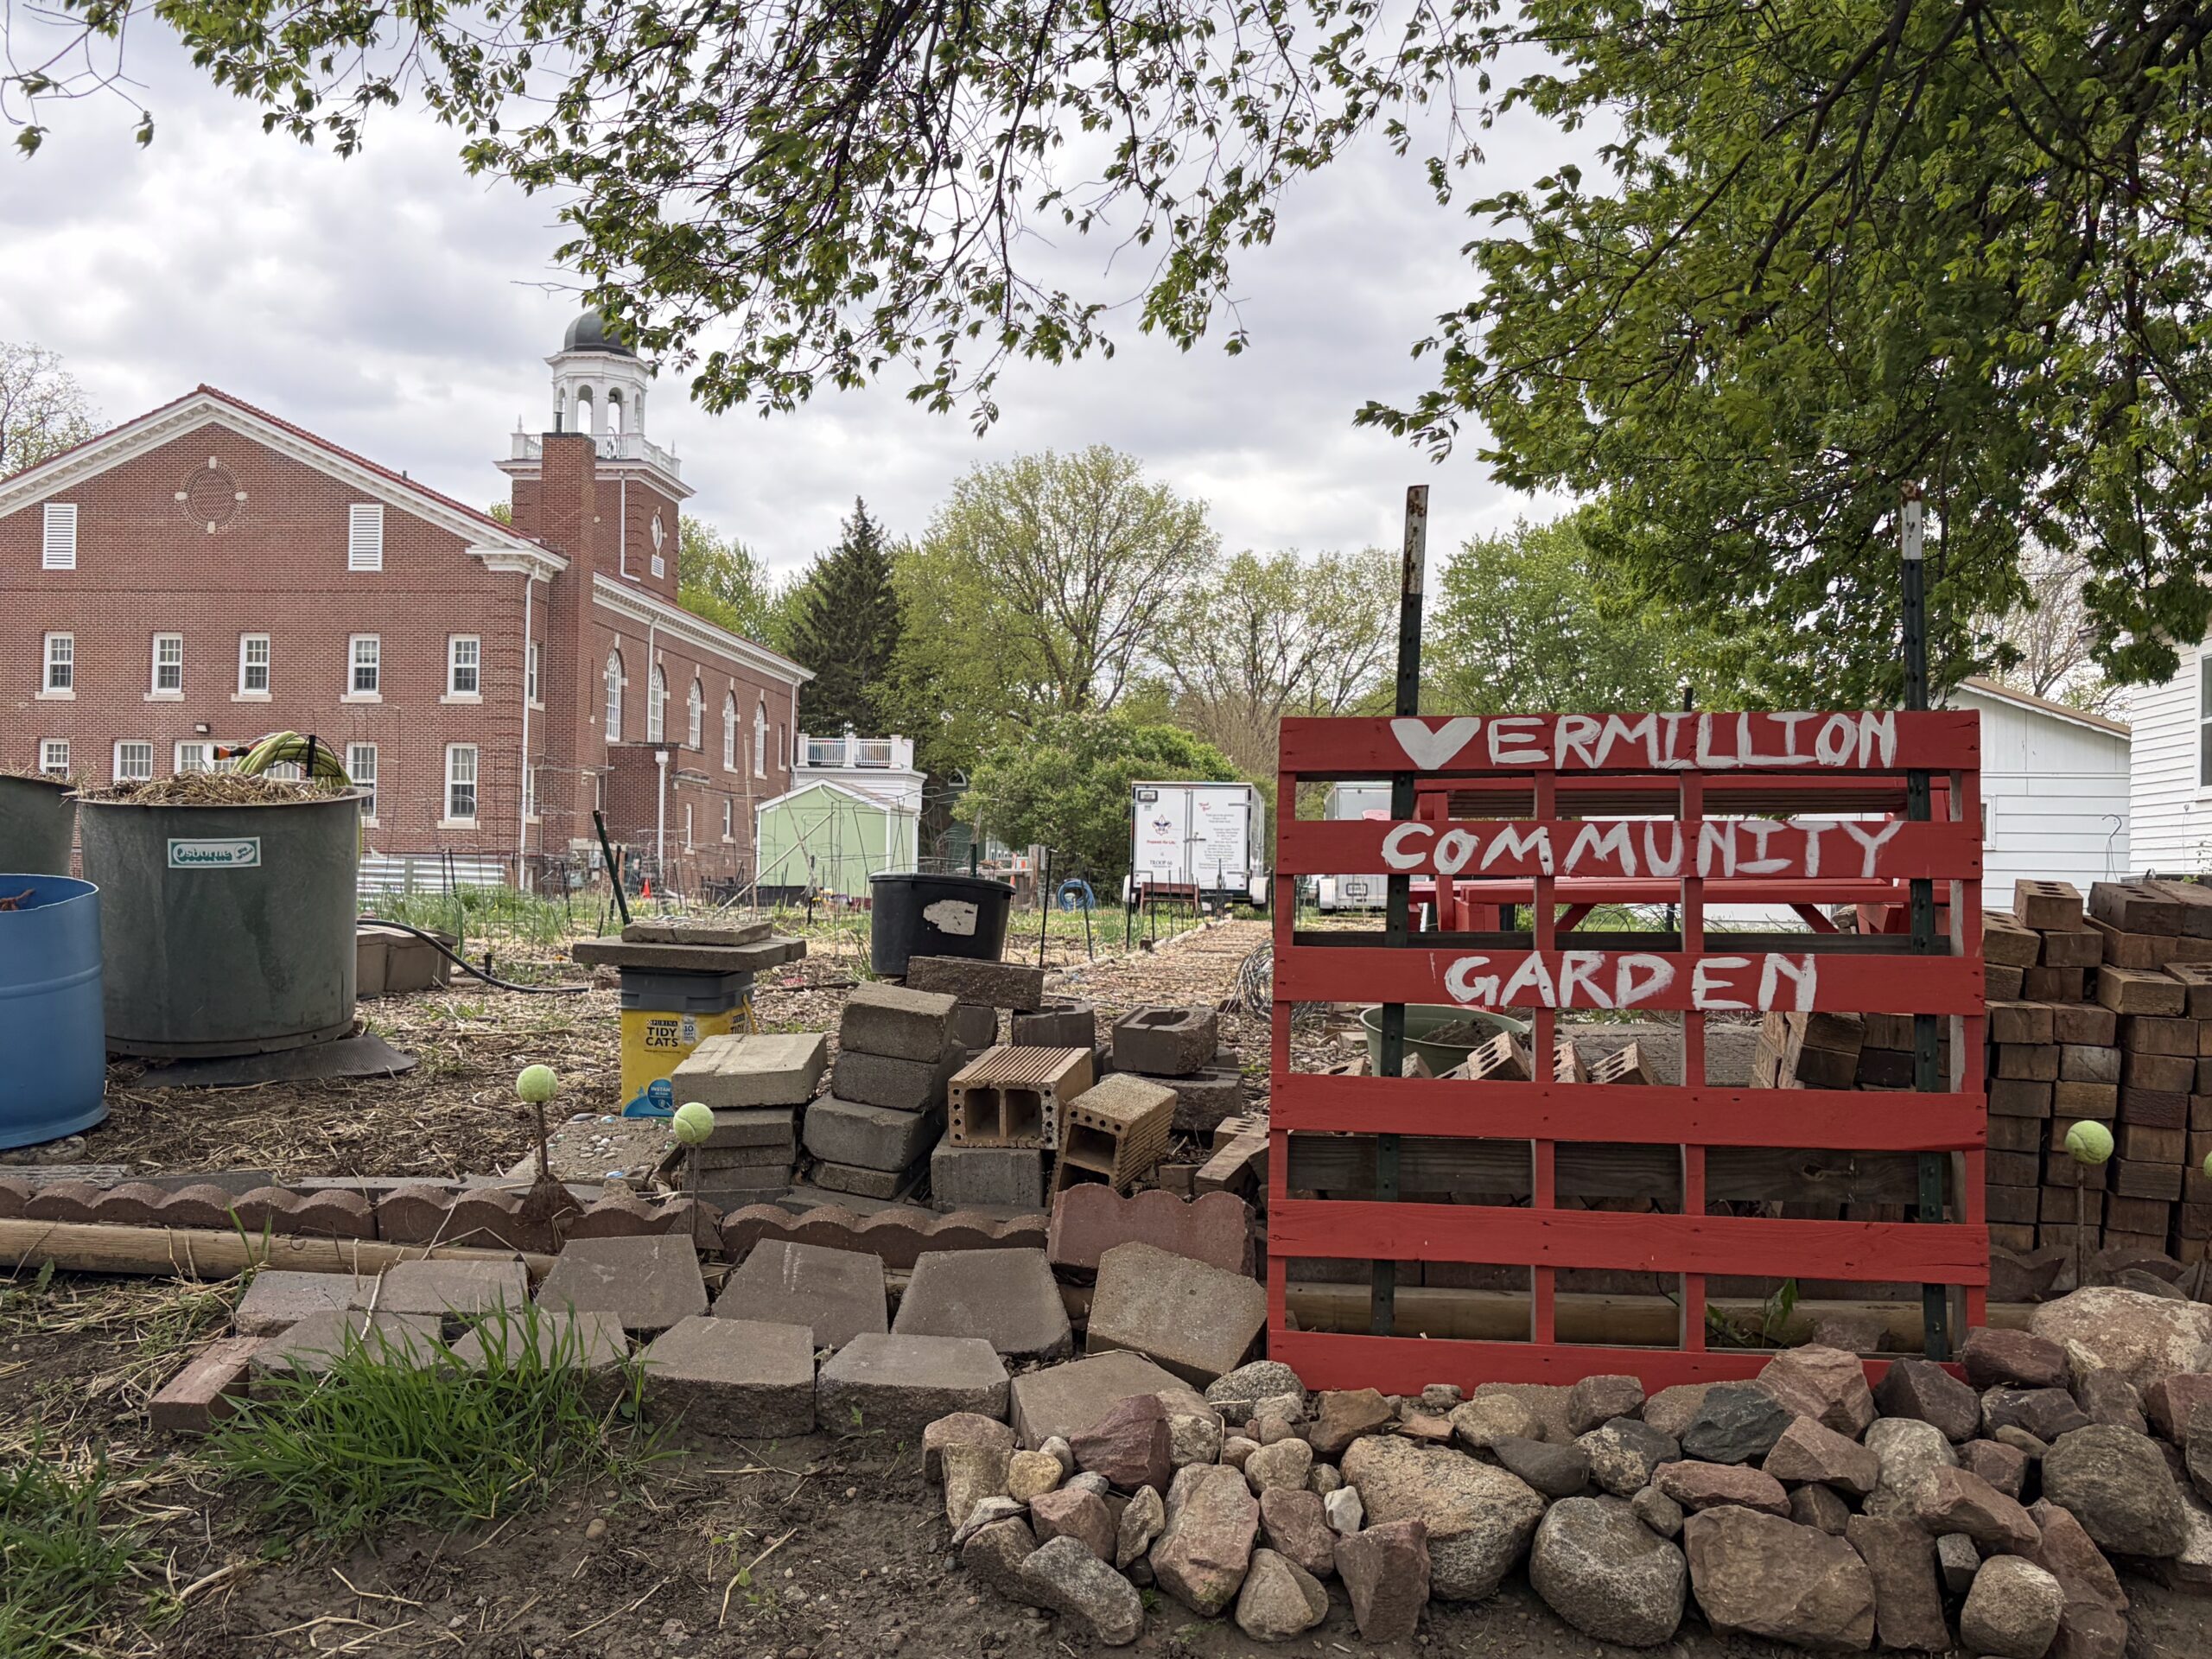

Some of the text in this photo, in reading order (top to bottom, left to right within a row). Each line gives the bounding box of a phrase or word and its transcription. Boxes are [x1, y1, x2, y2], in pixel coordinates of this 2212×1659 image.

[176, 848, 232, 861] Osborne
[1381, 820, 1903, 878] COMMUNITY
[1444, 950, 1817, 1012] GARDEN
[646, 1027, 677, 1037] TIDY
[645, 1037, 678, 1047] CATS
